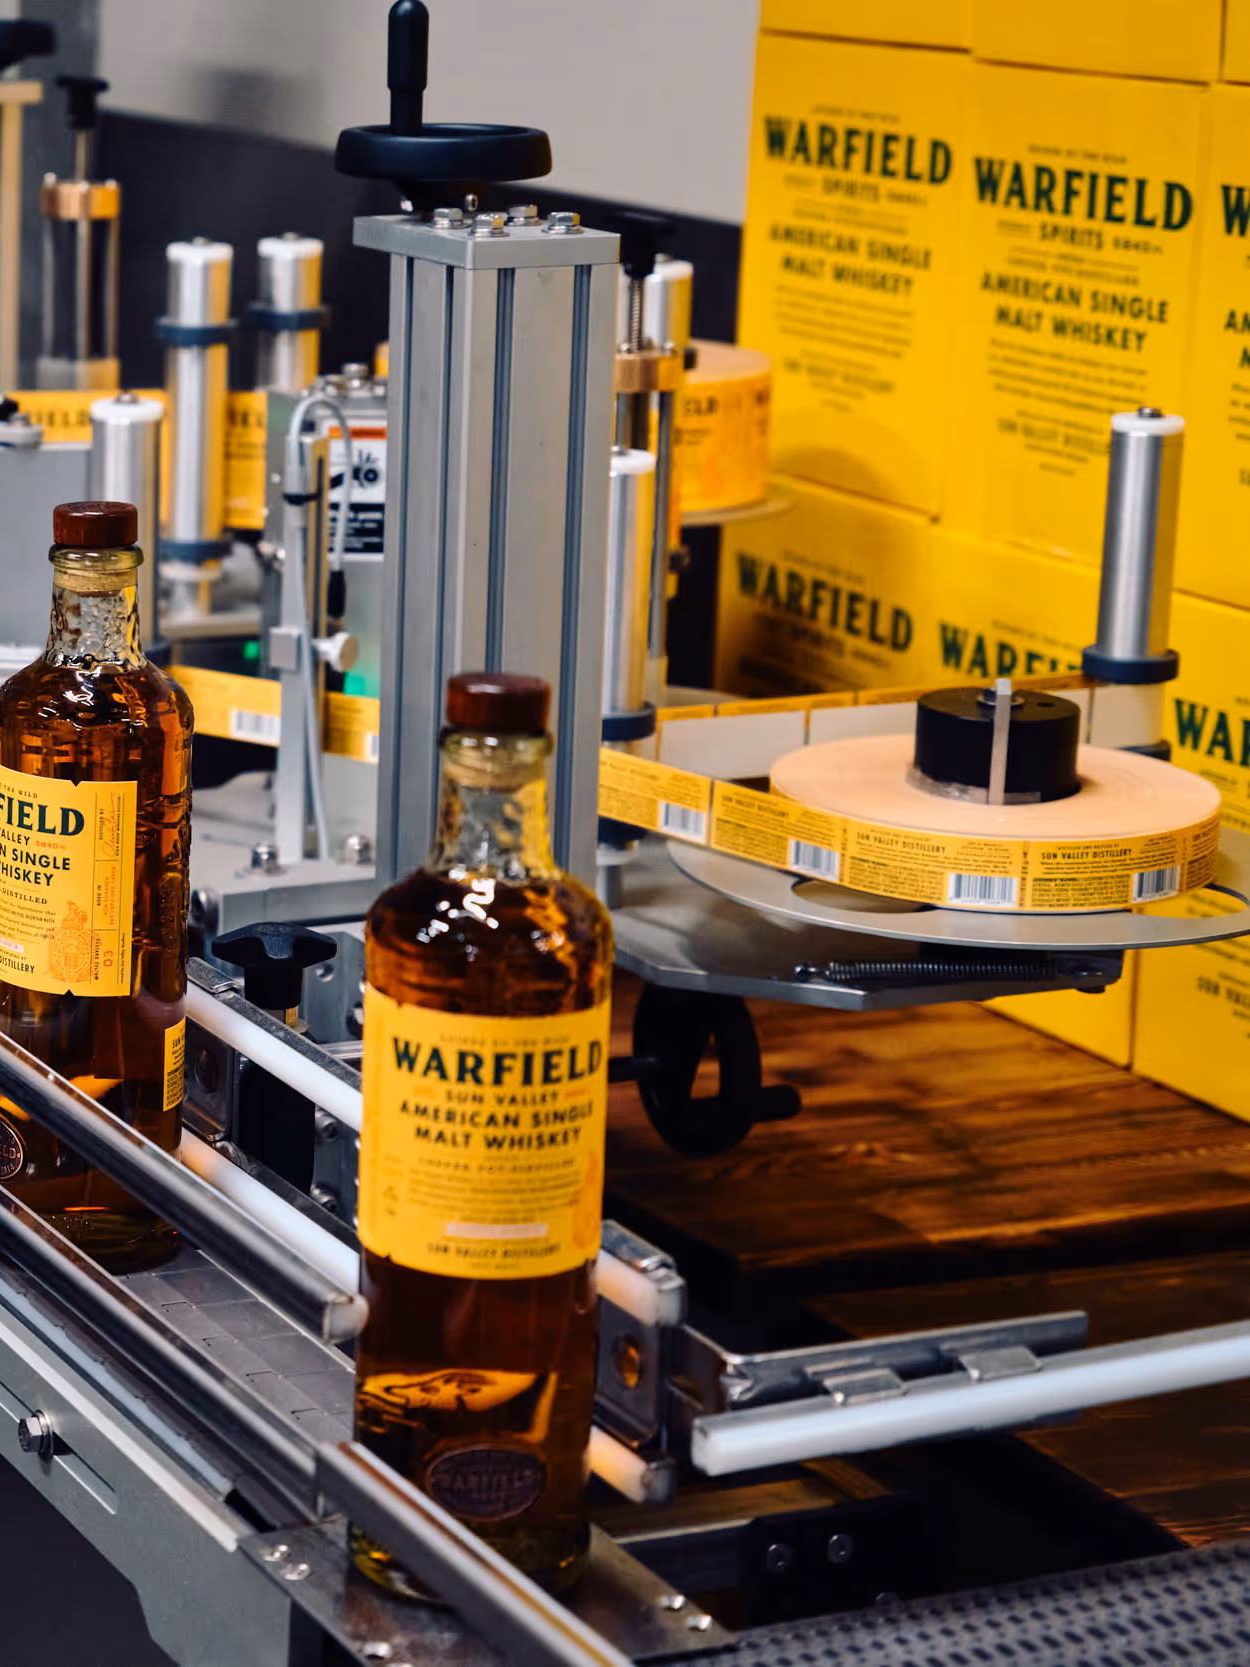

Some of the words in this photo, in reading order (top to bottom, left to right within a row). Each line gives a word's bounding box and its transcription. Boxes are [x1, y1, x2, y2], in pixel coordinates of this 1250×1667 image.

[764, 115, 953, 185] WARFIELD
[974, 156, 1193, 231] WARFIELD
[771, 223, 860, 255] AMERICAN
[867, 241, 932, 271] SINGLE
[1040, 221, 1104, 250] SPIRITS
[981, 272, 1083, 307] AMERICAN
[1090, 290, 1169, 324] SINGLE
[994, 305, 1043, 334] MALT
[1053, 316, 1147, 352] WHISKEY
[736, 553, 913, 652] WARFIELD
[18, 789, 38, 799] WILD
[12, 848, 71, 871] SINGLE
[902, 841, 946, 855] DISTILLERY
[1041, 851, 1058, 861] SUN
[1061, 851, 1090, 861] VALLEY
[1092, 848, 1133, 860] DISTILLERY
[103, 950, 114, 967] 03
[392, 1037, 602, 1085] WARFIELD
[446, 1090, 484, 1104] SUN
[493, 1091, 559, 1106] VALLEY
[401, 1100, 520, 1128] AMERICAN
[532, 1101, 594, 1128] SINGLE
[415, 1126, 473, 1149] MALT
[484, 1126, 582, 1150] WHISKEY
